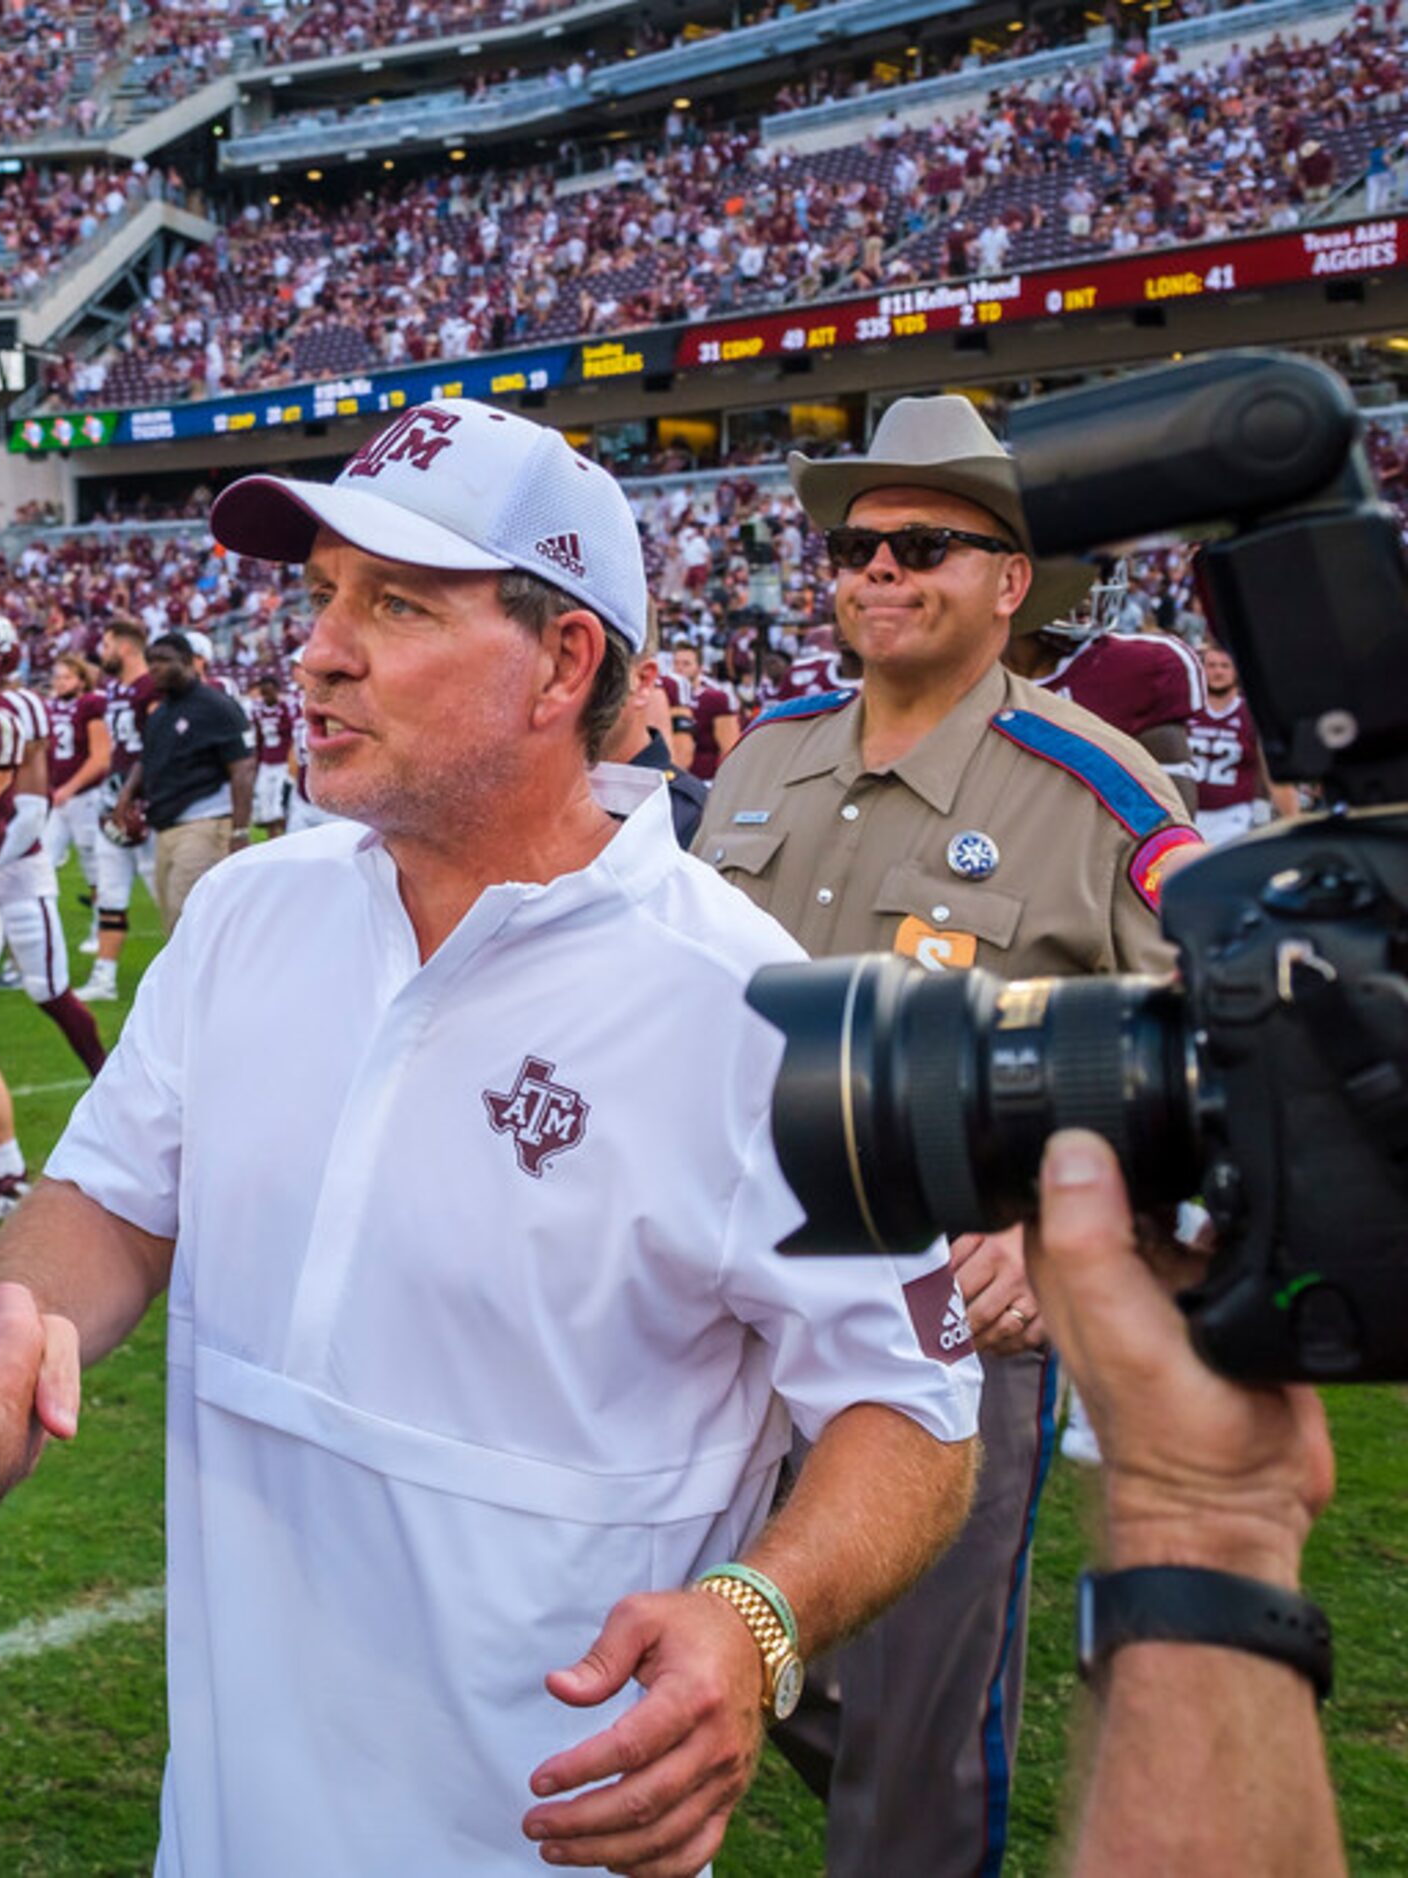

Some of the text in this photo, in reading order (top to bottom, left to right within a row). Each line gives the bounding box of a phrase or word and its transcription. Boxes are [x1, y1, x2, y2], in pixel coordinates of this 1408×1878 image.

[1303, 231, 1351, 253] Texas
[1312, 242, 1398, 276] AGGIES
[698, 341, 720, 363] 31
[781, 328, 806, 350] 49
[807, 326, 837, 348] ATT
[855, 316, 891, 341] 335
[893, 313, 928, 337] YDS
[959, 304, 975, 326] 2
[977, 302, 1003, 324] TD
[1045, 290, 1064, 314] 0
[1063, 287, 1097, 312] INT
[1145, 272, 1203, 300] LONG:
[1204, 264, 1235, 290] 41
[535, 541, 586, 579] adidas
[51, 720, 75, 760] 3
